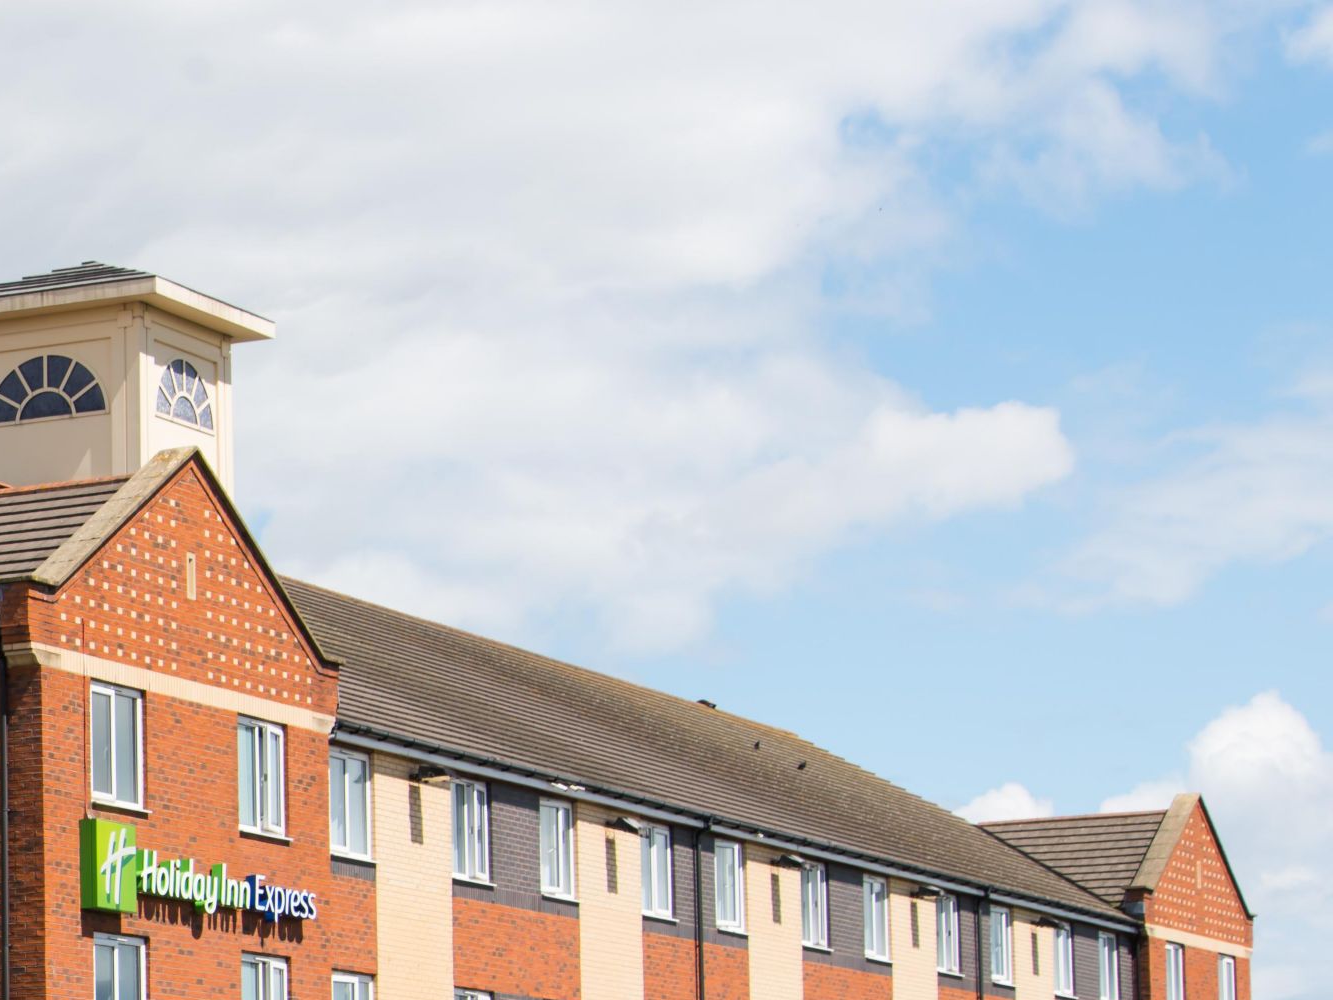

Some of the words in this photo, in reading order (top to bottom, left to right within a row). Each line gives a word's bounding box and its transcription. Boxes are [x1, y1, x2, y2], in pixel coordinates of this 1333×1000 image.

[138, 849, 220, 914] Holiday
[216, 863, 252, 910] Inn
[252, 874, 317, 923] Express
